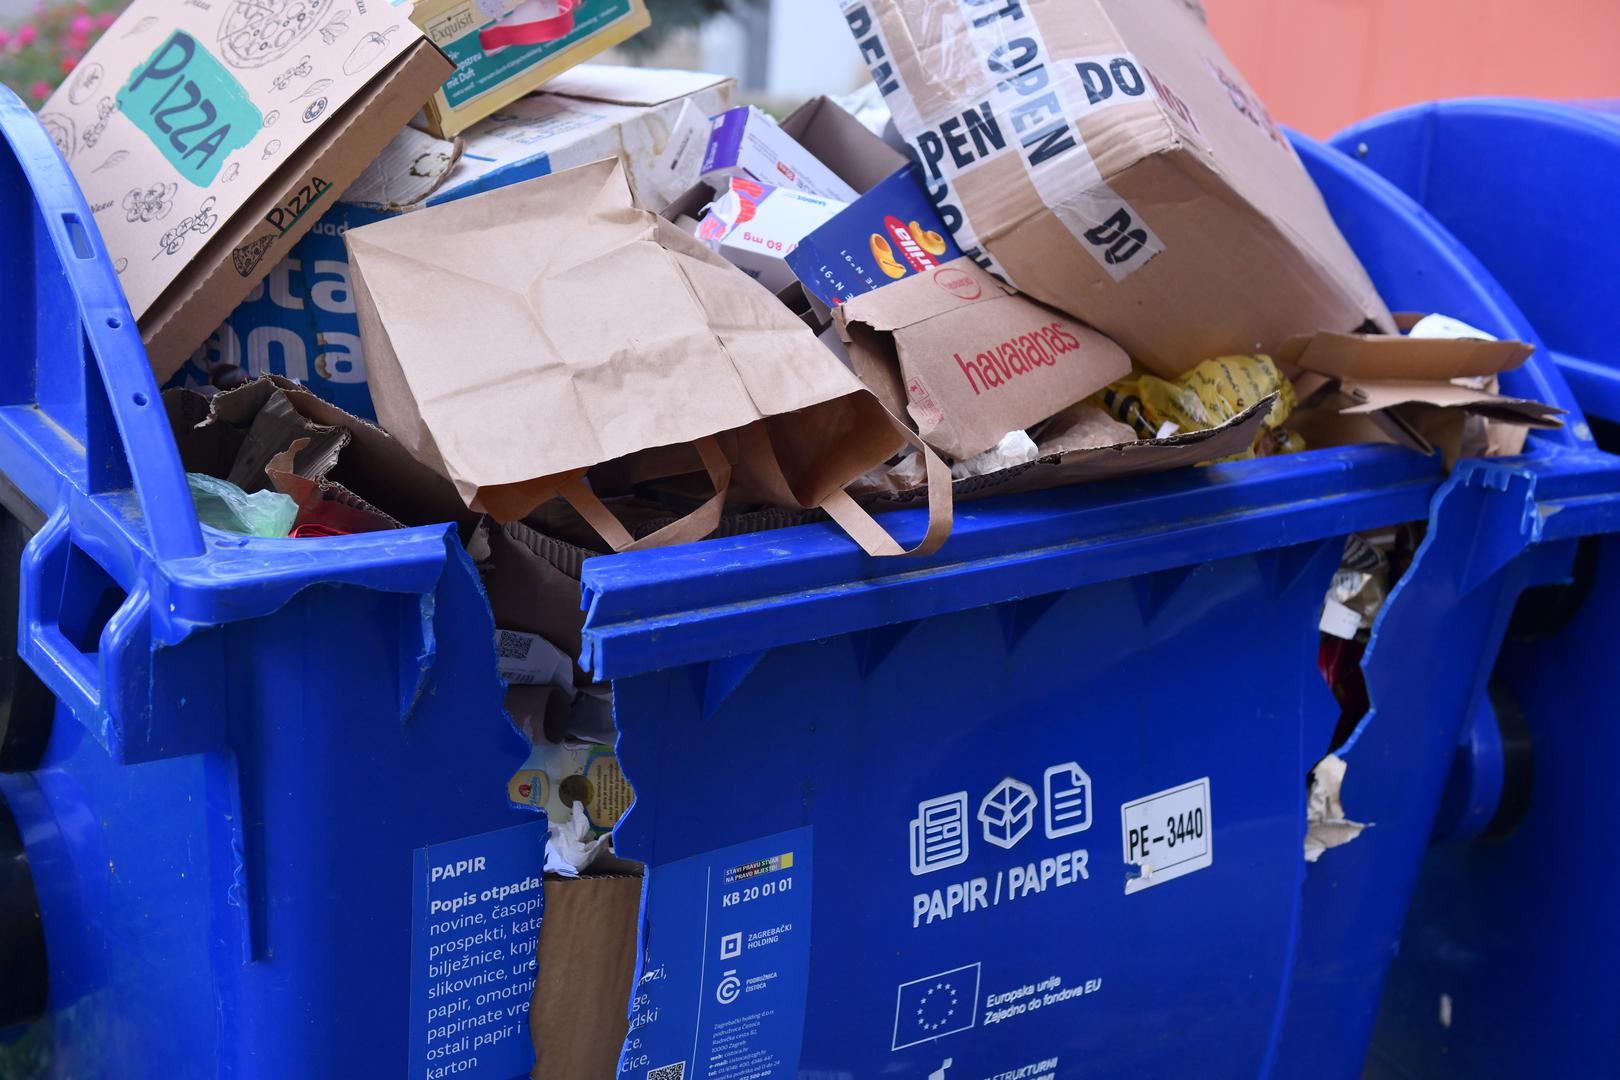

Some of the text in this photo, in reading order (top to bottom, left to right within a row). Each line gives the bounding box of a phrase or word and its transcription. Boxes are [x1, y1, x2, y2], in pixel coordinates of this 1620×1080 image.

[430, 13, 475, 43] Exquisit
[458, 68, 476, 83] Duft
[1074, 57, 1146, 105] DO
[128, 31, 231, 171] PIZZA
[985, 36, 1078, 167] OPEN
[910, 101, 1007, 181] PEN
[265, 176, 331, 232] PIZZA
[743, 231, 764, 244] mg
[766, 239, 783, 252] 80
[1083, 207, 1148, 265] DO
[953, 322, 1081, 395] havaianas
[431, 856, 486, 882] PAPIR
[431, 892, 477, 915] Popis
[722, 877, 792, 908] KB 20 01 01
[912, 876, 989, 928] PAPIR
[1008, 849, 1090, 900] PAPER
[430, 912, 487, 936] novine,
[748, 923, 792, 942] ZAGREBAČKI
[429, 924, 507, 961] prospekti,
[429, 936, 539, 978] bilježnice, knji
[747, 935, 779, 949] HOLDING
[428, 968, 508, 999] slikovnice,
[745, 971, 778, 985] PODRUŽNICA
[745, 982, 767, 993] ČISTOĆA
[986, 975, 1062, 1008] Europska unija
[428, 997, 471, 1024] papir,
[983, 977, 1102, 1026] Zajedno do fondova EU
[426, 1020, 521, 1061] ostali papir i
[427, 1010, 503, 1045] papirnate
[426, 1057, 478, 1080] karton
